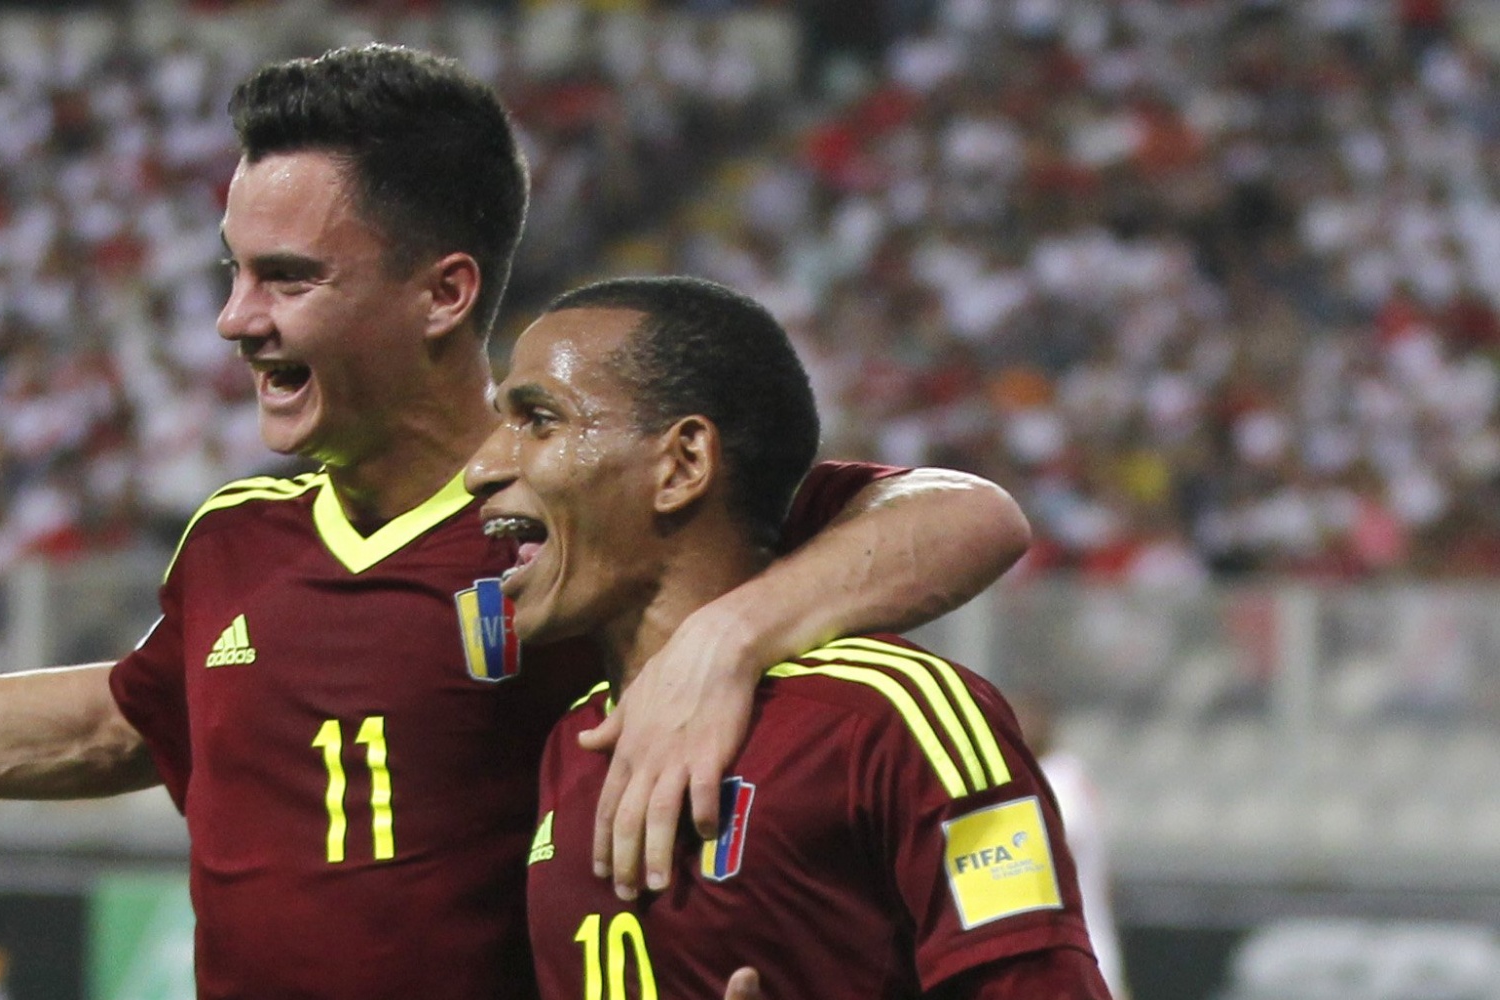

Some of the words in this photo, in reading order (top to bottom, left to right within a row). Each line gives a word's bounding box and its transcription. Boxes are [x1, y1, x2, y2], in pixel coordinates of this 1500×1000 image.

[205, 648, 256, 668] adidas
[312, 716, 395, 863] 11
[955, 846, 1012, 874] FIFA
